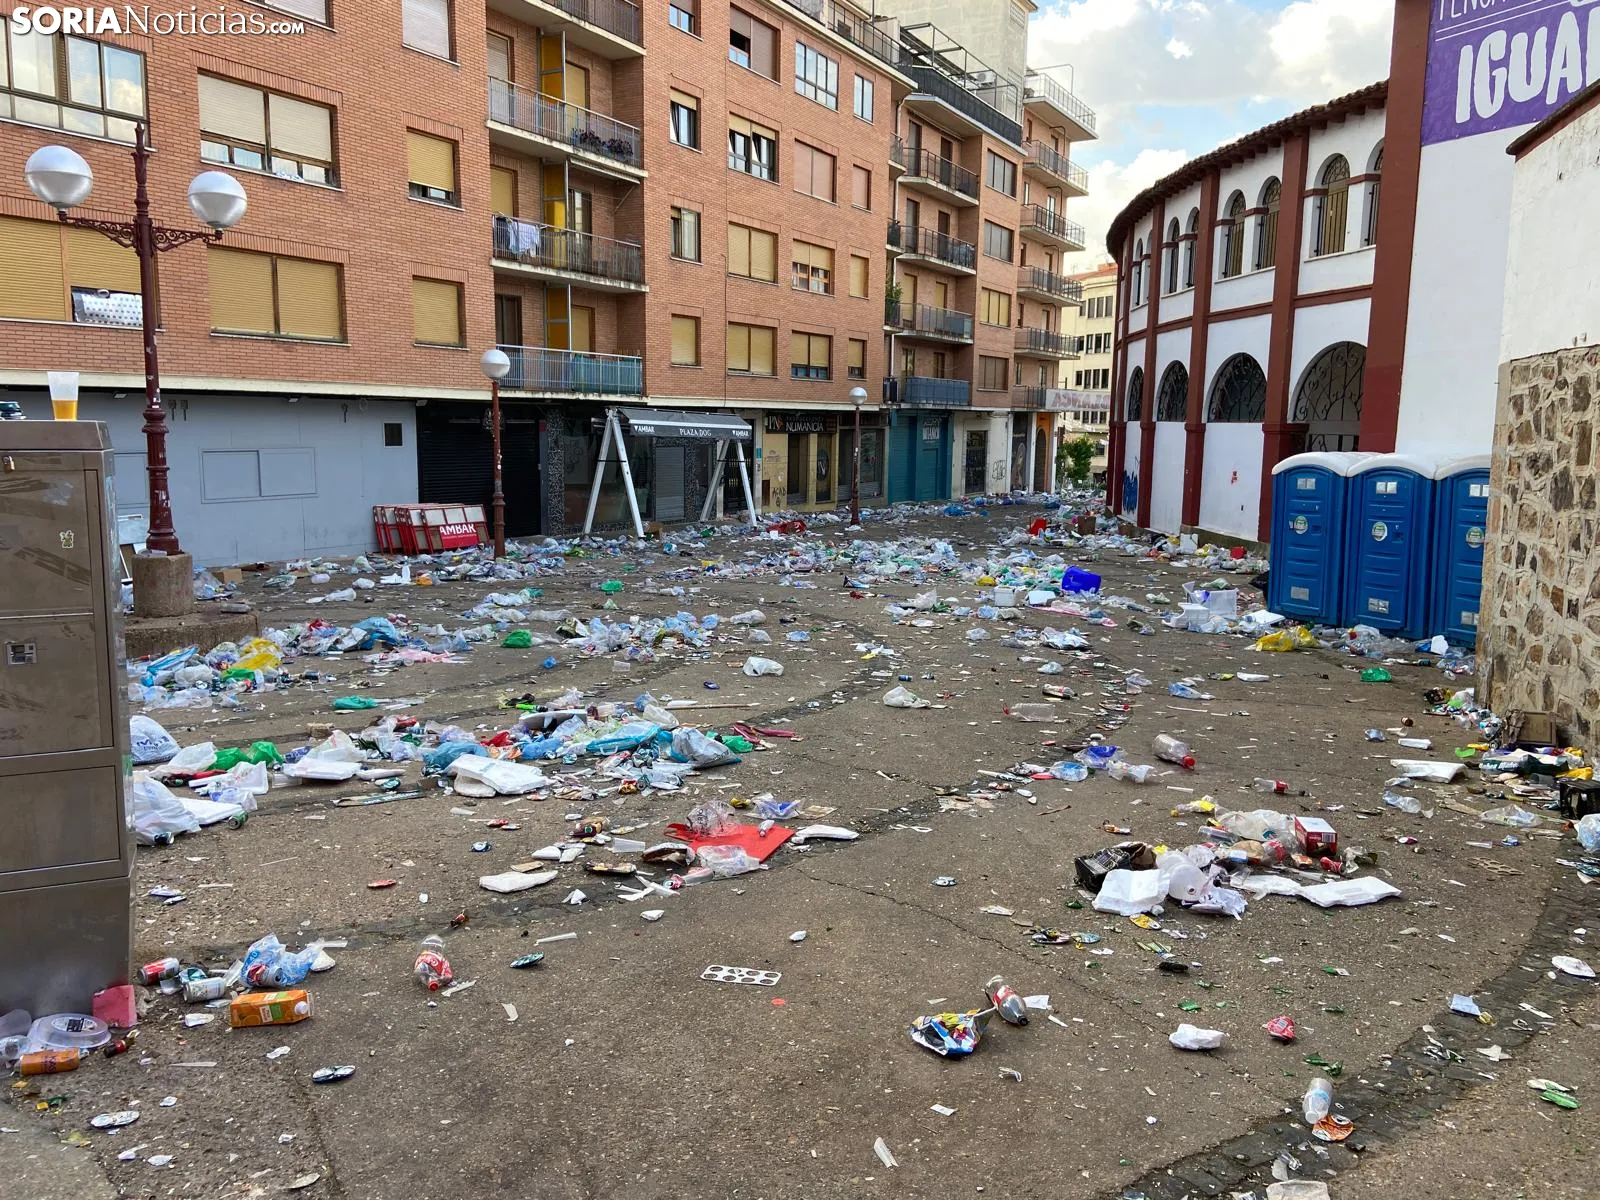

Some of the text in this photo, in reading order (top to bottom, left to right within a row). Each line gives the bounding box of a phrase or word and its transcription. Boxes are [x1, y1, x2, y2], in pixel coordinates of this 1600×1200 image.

[637, 425, 655, 433] AMBAR
[785, 422, 824, 432] NUMANCIA
[680, 428, 712, 437] PLAZA DOG
[735, 429, 750, 437] AMBAR
